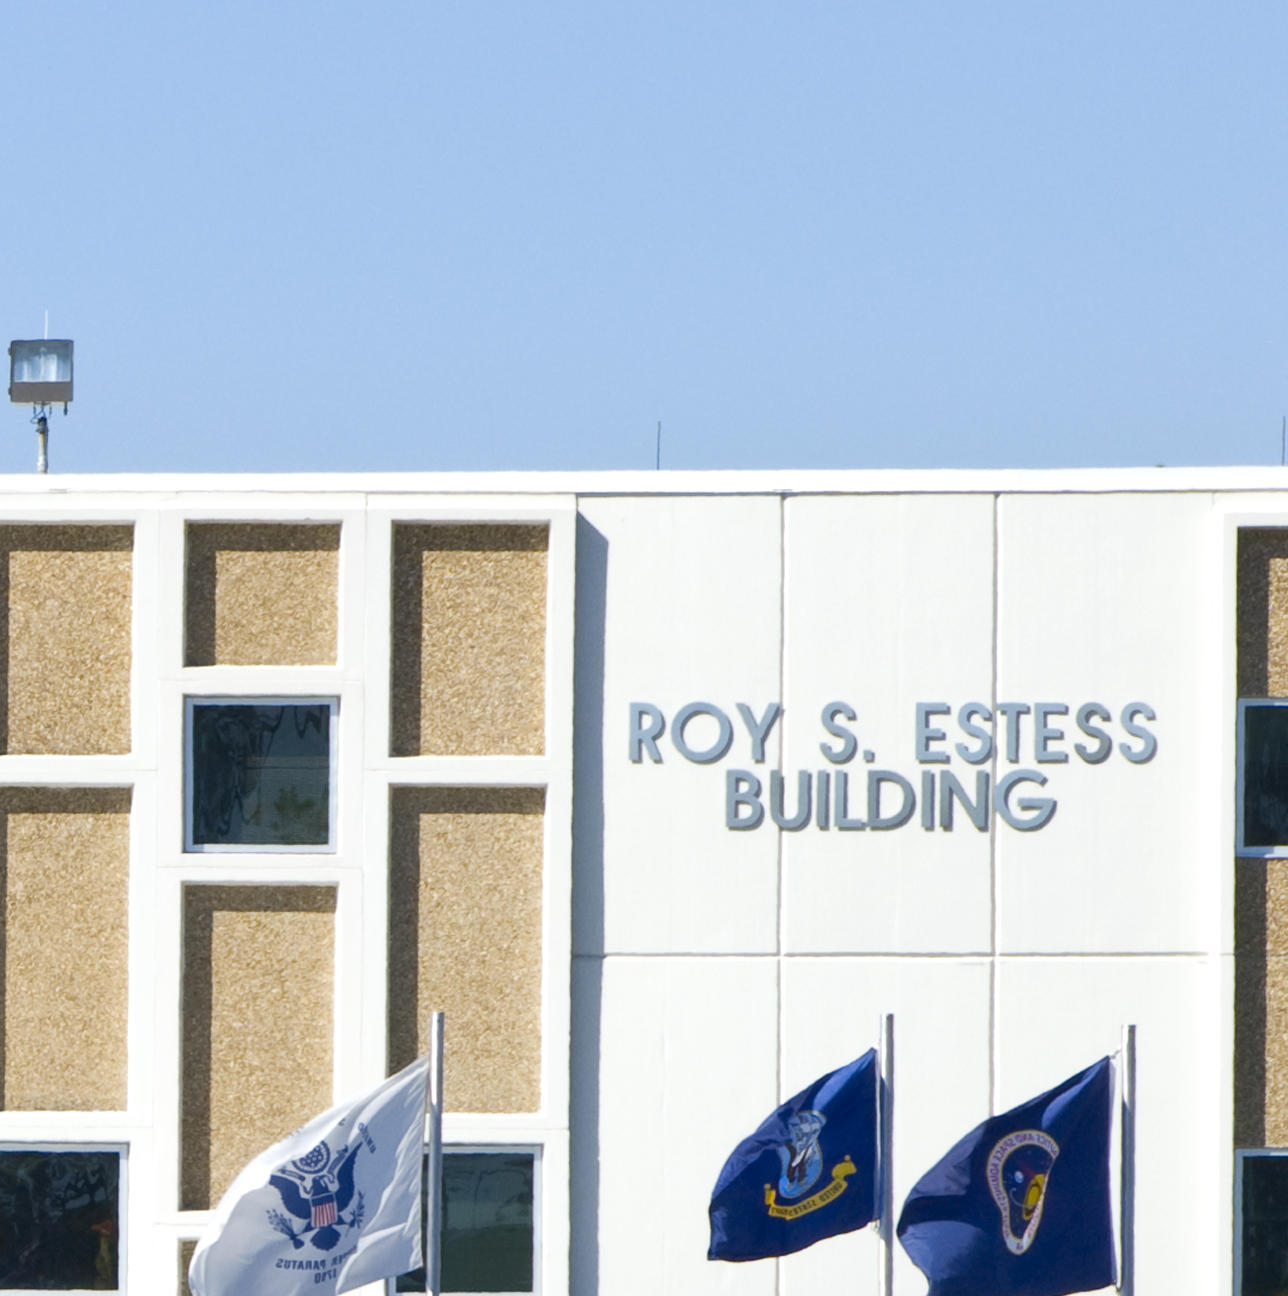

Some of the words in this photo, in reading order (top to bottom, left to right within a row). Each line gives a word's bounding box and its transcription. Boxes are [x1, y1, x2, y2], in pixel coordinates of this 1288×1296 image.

[628, 701, 785, 765] ROY
[819, 700, 876, 765] S.
[914, 701, 1159, 765] ESTESS
[724, 768, 1058, 833] BUILDING
